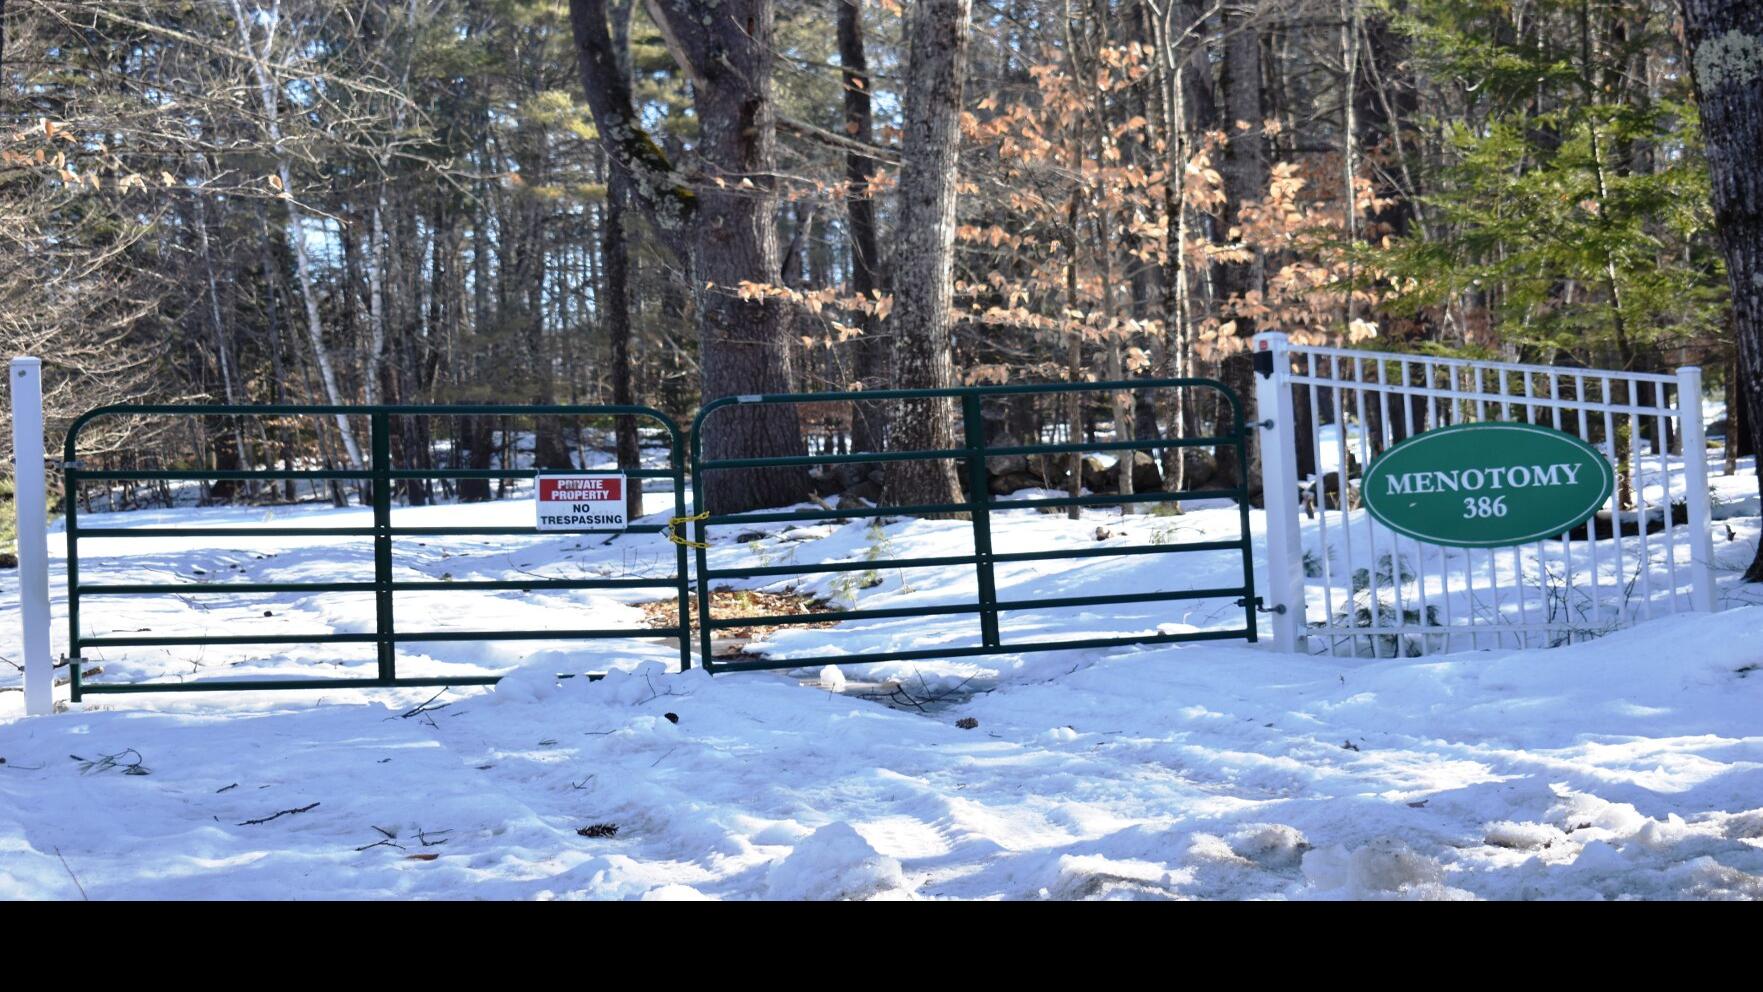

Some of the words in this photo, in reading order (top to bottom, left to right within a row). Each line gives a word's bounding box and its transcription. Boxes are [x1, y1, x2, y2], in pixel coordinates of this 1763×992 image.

[557, 479, 603, 489] PRIVATE
[1385, 463, 1582, 495] MENOTOMY
[551, 489, 609, 500] PROPERTY
[573, 504, 590, 513] NO
[1463, 495, 1508, 519] 386
[540, 515, 623, 525] TRESPASSING
